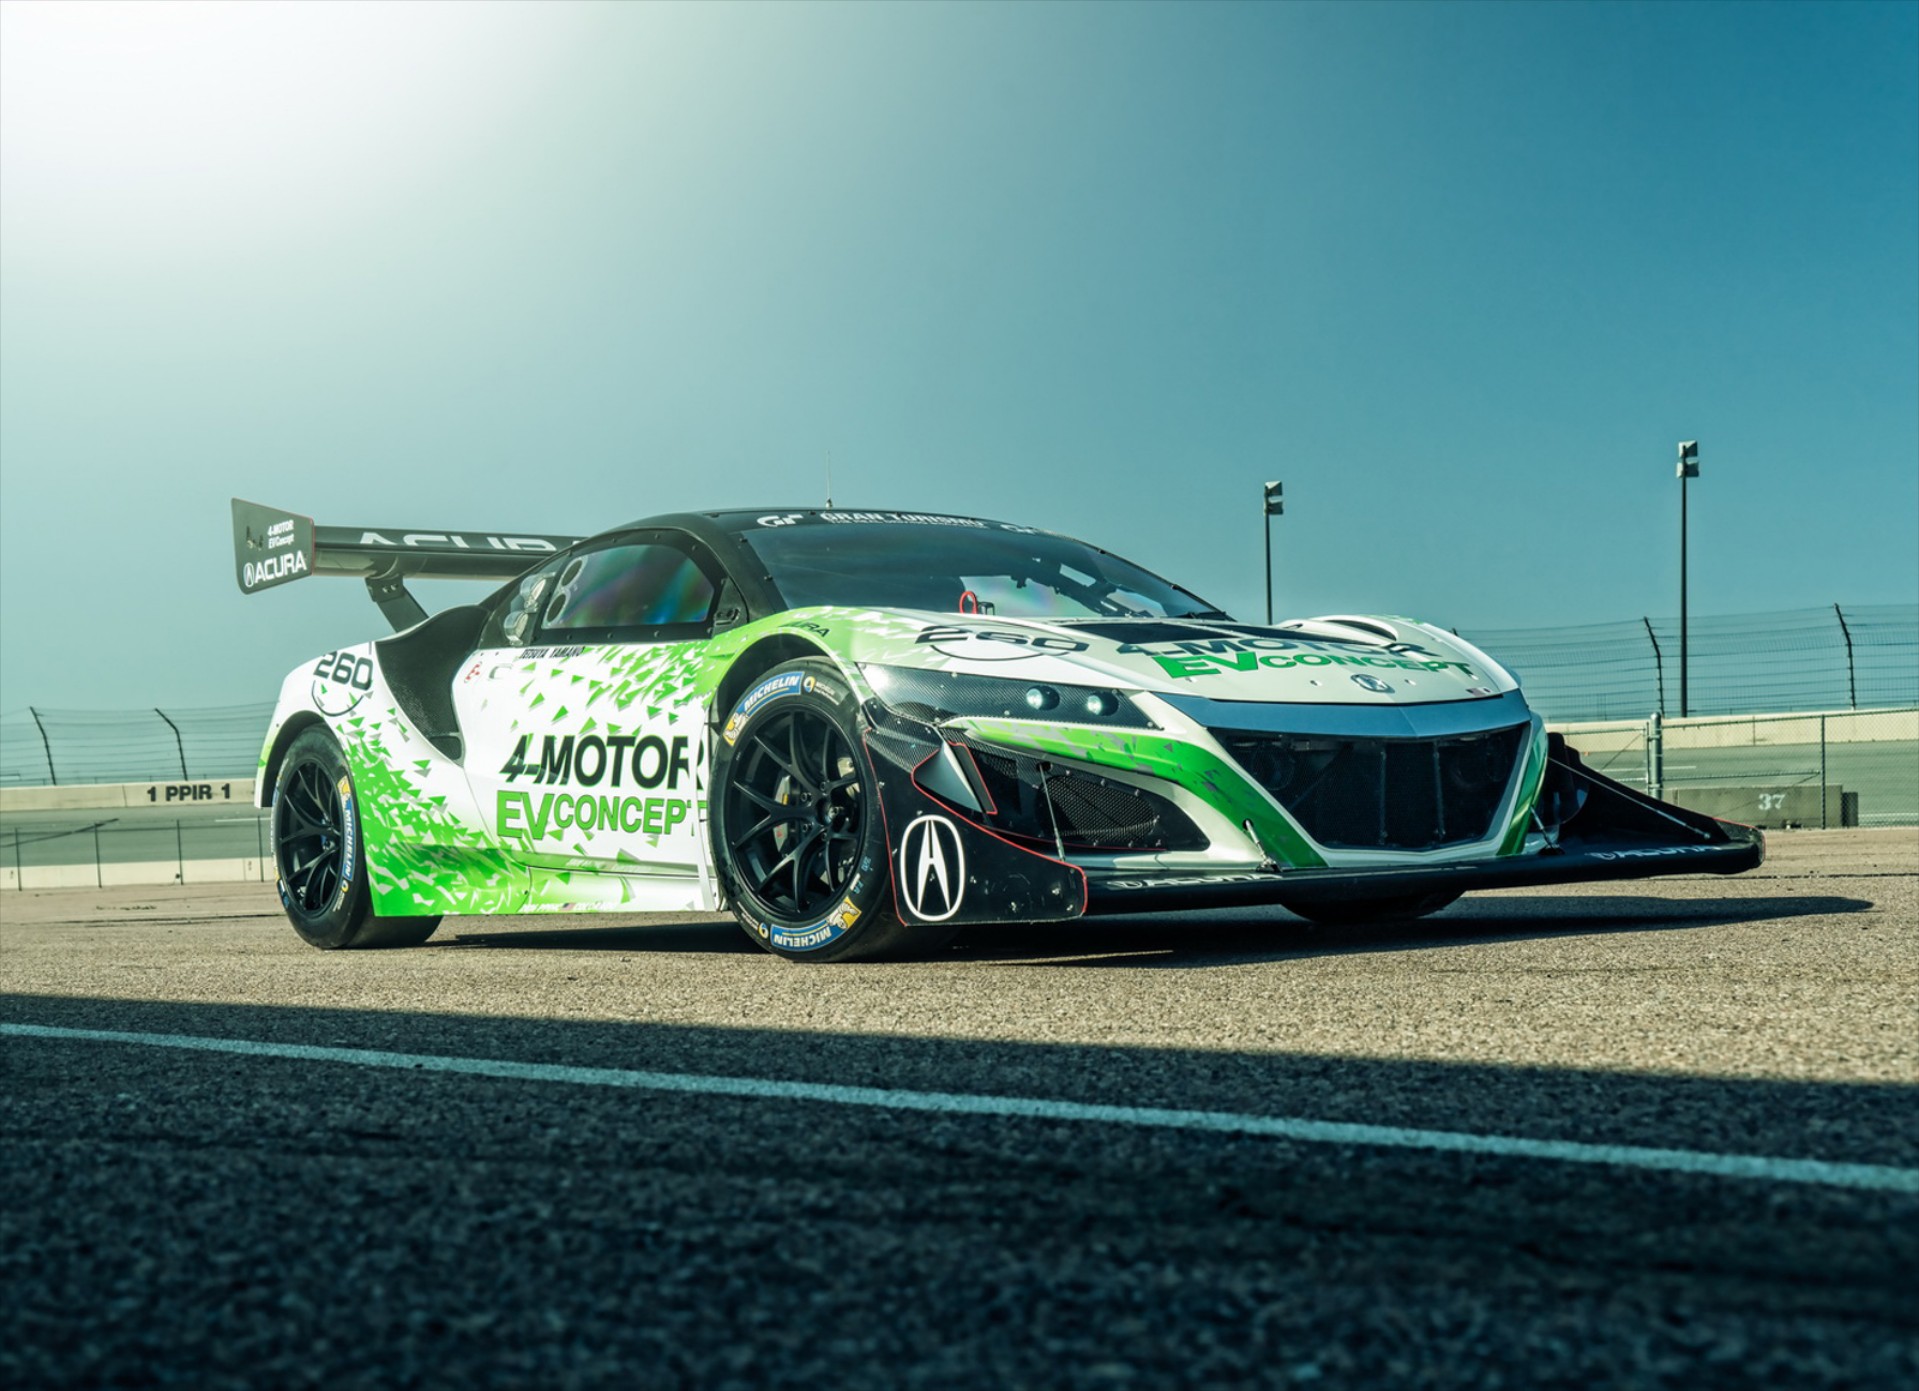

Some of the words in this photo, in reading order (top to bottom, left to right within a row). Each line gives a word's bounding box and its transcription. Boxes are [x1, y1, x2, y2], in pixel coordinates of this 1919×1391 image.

[267, 519, 294, 537] 4-MOTOR
[360, 532, 582, 551] ACUR
[254, 550, 307, 583] ACURA
[915, 625, 1090, 652] 260
[313, 650, 374, 691] 260
[744, 675, 800, 711] MICHELIN
[498, 733, 705, 791] 4-MOTOR
[147, 785, 157, 802] 1
[165, 783, 213, 802] PPIR
[221, 782, 231, 800] 1
[1758, 793, 1787, 810] 37
[344, 809, 354, 877] MICHELIN
[774, 925, 832, 948] MICHELIN
